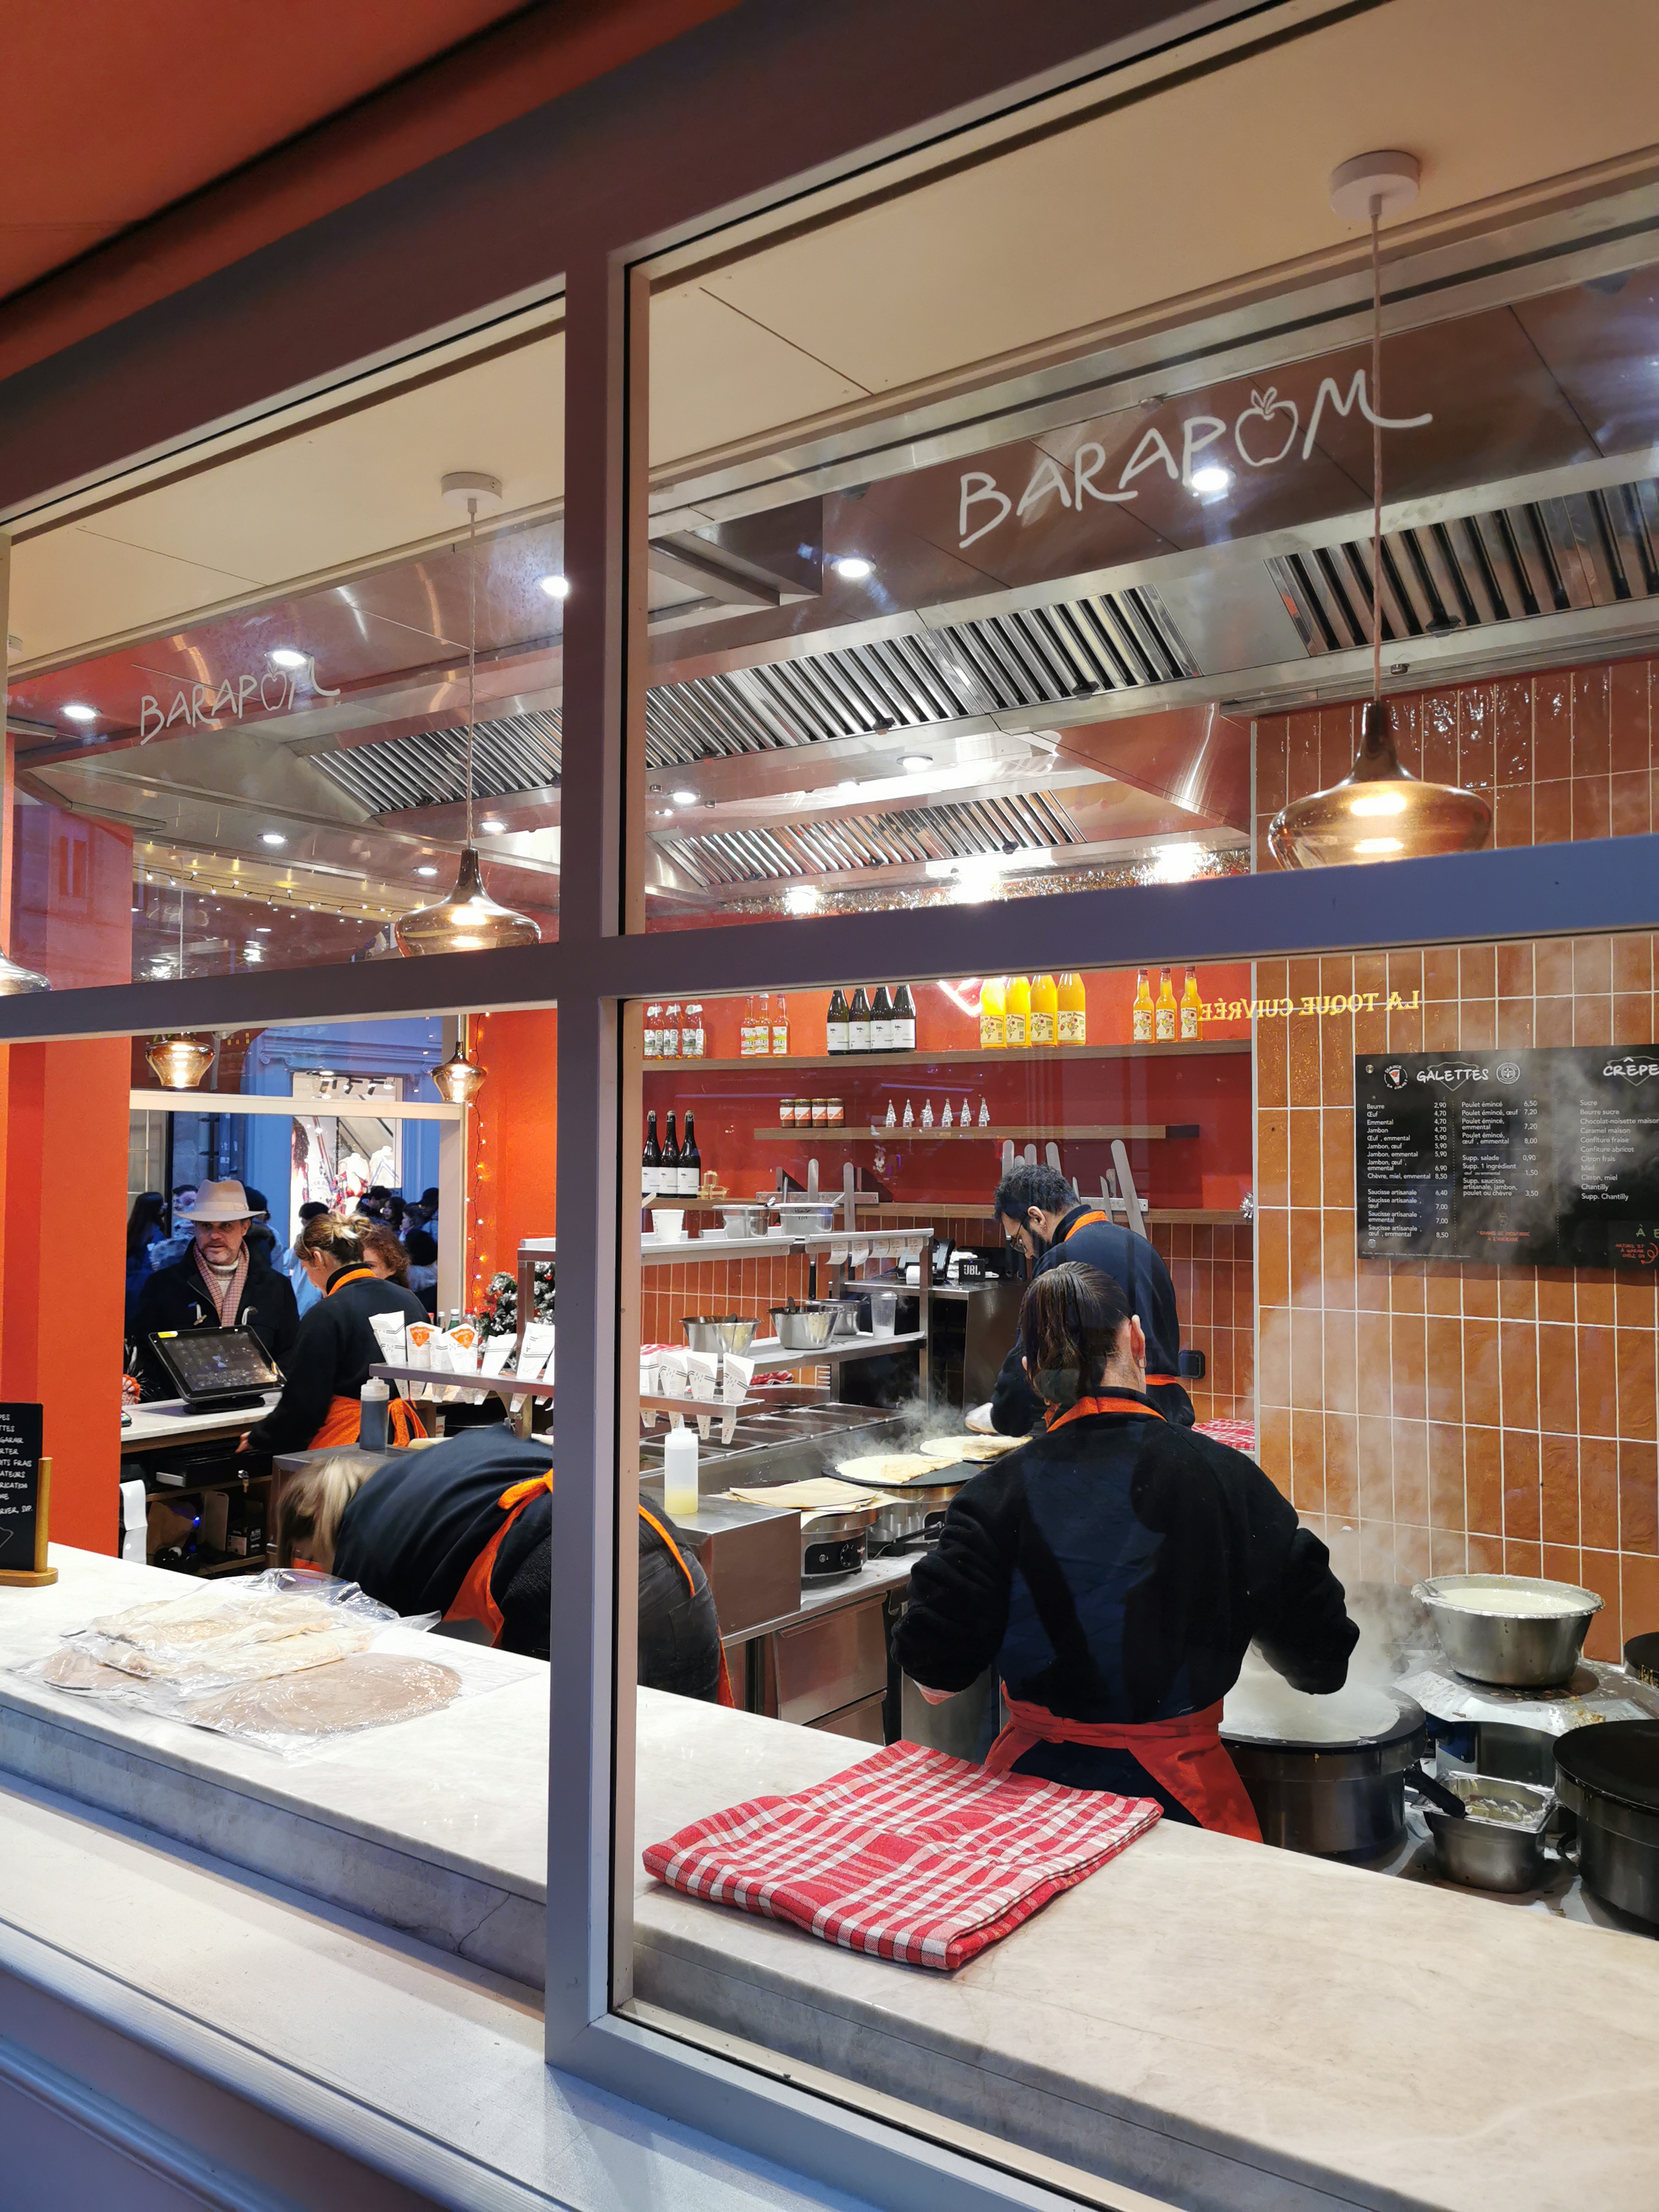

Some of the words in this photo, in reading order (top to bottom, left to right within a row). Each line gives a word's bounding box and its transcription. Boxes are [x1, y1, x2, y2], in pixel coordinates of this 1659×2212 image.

[959, 369, 1432, 548] BARAPOM
[1416, 1068, 1489, 1084] GALETTES
[964, 1264, 980, 1276] JBL
